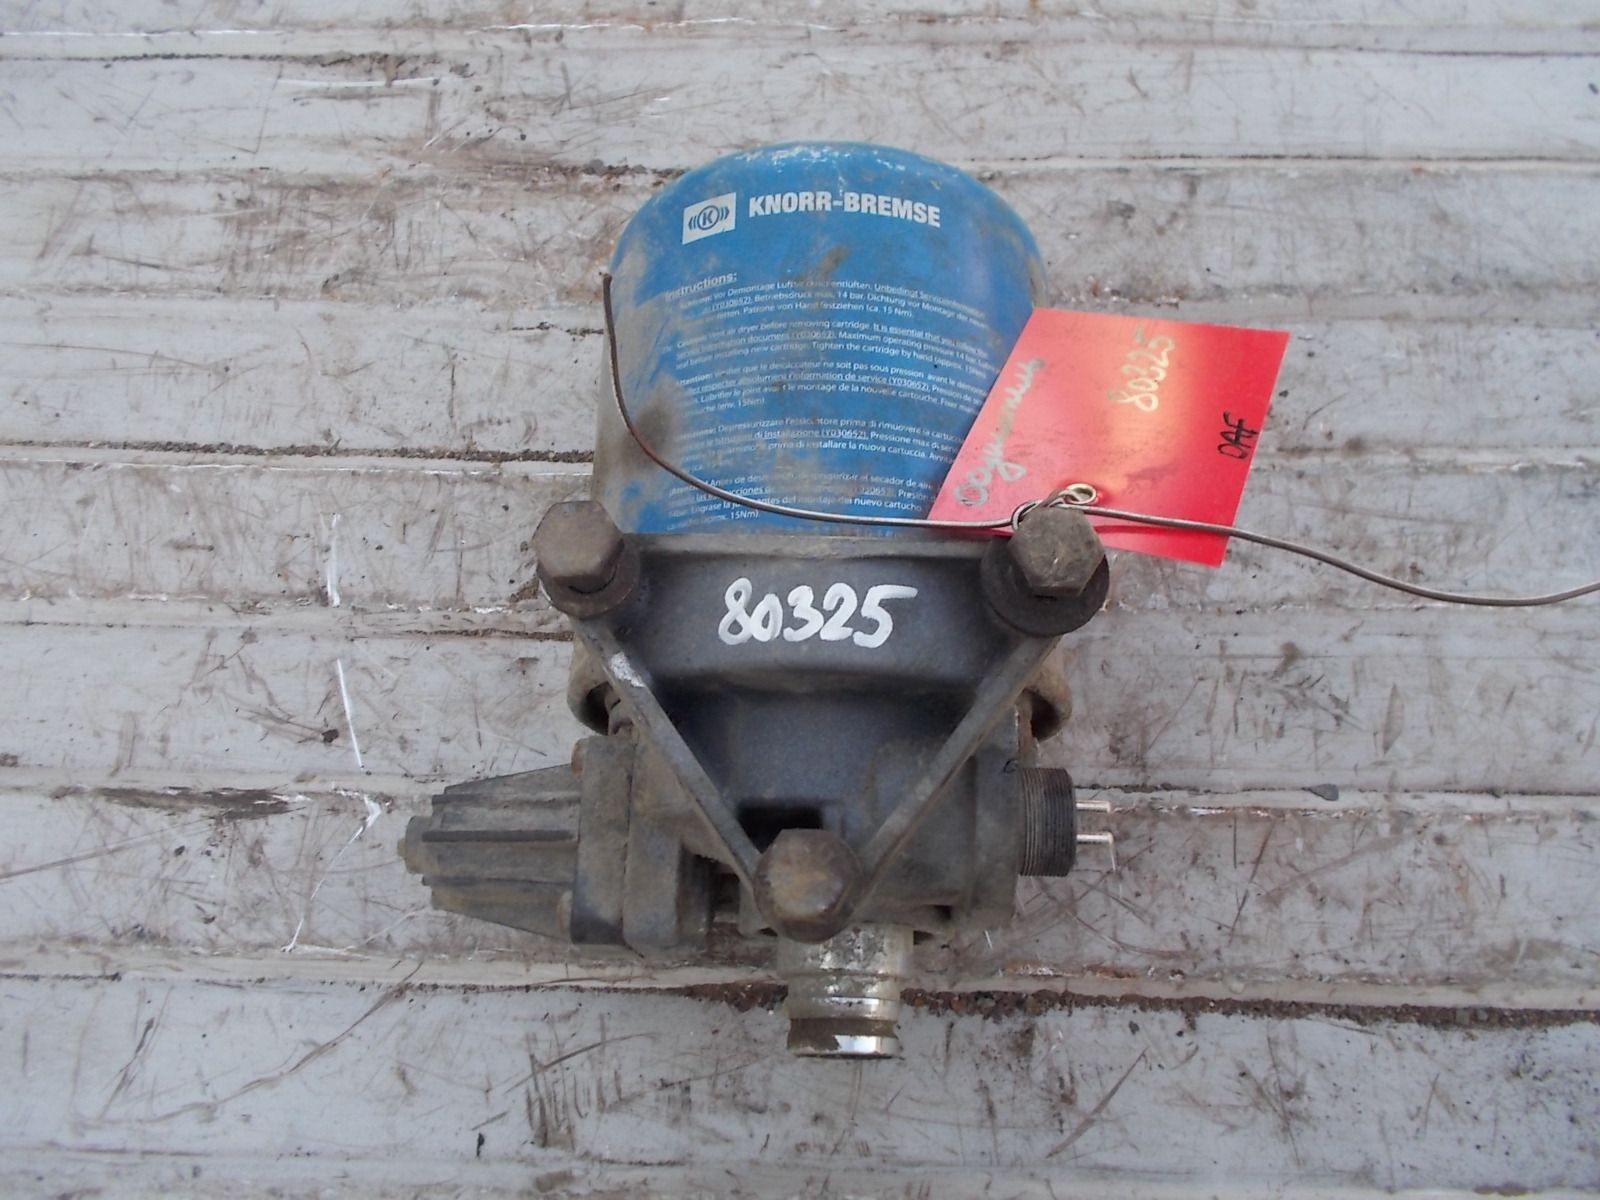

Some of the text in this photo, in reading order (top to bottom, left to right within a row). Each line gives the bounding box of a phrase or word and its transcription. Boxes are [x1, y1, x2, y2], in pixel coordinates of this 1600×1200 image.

[749, 191, 941, 228] KNORR-BREMSE
[838, 331, 881, 341] Maximum
[812, 341, 845, 352] Tighten
[846, 342, 861, 351] the
[862, 344, 900, 358] cartridge
[901, 348, 912, 359] by
[823, 361, 834, 369] ne
[835, 361, 853, 369] soit
[853, 362, 869, 372] pas
[869, 363, 889, 373] sous
[890, 366, 925, 379] pression
[1106, 325, 1176, 412] 80325
[844, 372, 857, 381] de
[857, 374, 888, 384] service
[797, 383, 837, 393] montage
[838, 382, 850, 391] de
[851, 384, 860, 392] la
[839, 418, 867, 428] prima
[870, 430, 912, 444] Pressione
[1216, 410, 1259, 460] DAF
[848, 441, 858, 450] la
[858, 443, 887, 453] nuova
[853, 497, 883, 508] nuevo
[716, 576, 919, 649] 80325
